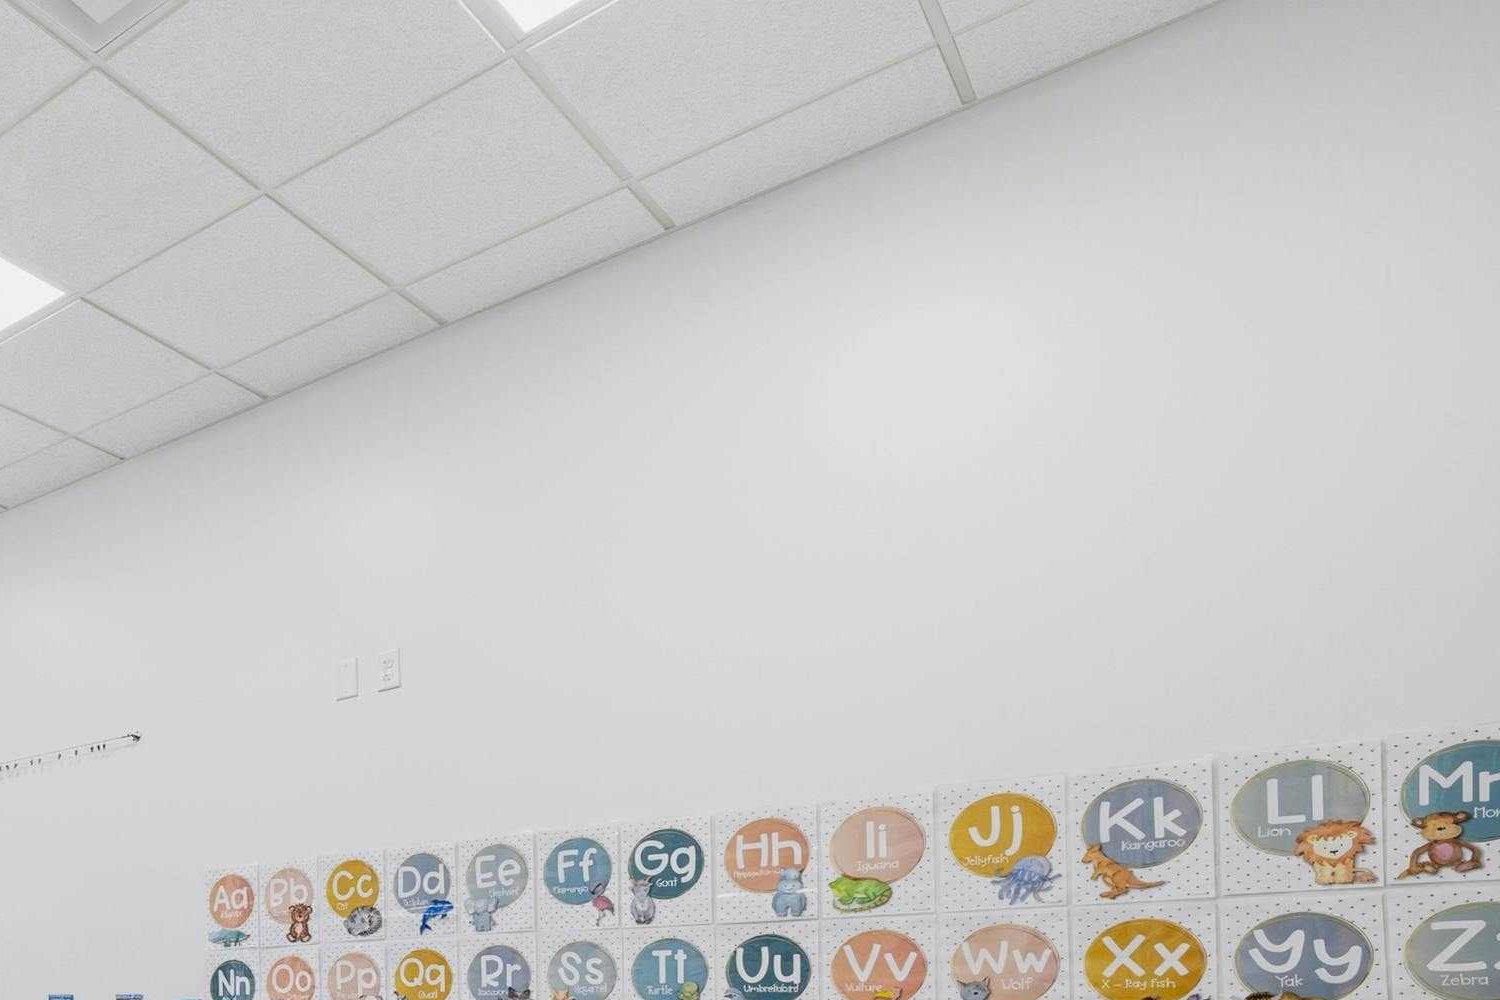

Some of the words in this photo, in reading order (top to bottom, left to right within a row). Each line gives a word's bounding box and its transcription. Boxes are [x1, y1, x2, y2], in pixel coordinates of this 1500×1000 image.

[1266, 774, 1324, 825] Ll
[968, 805, 1022, 857] Jj
[1100, 796, 1188, 843] Kk
[1257, 825, 1291, 838] Lion
[736, 831, 803, 870] Hh
[866, 821, 887, 859] Ii
[1121, 838, 1186, 852] Kangaroo
[475, 854, 521, 889] Ee
[557, 847, 597, 883] Ff
[634, 839, 697, 883] Gg
[856, 860, 899, 873] Iguana
[963, 854, 1009, 868] Jellyfish
[269, 878, 308, 907] Bb
[332, 870, 373, 901] Cc
[397, 864, 446, 898] Dd
[656, 877, 678, 888] Goat
[213, 885, 248, 912] Aa
[962, 940, 1052, 975] Ww
[1101, 933, 1189, 978] Xx
[1248, 928, 1362, 984] Yy
[1426, 919, 1500, 972] Z
[272, 964, 311, 993] Oo
[335, 960, 377, 994] Pp
[400, 957, 446, 992] Qq
[480, 954, 522, 988] Rr
[558, 951, 604, 986] Ss
[652, 949, 687, 984] Tt
[735, 946, 801, 985] Uu
[843, 943, 918, 983] Vv
[1440, 972, 1489, 986] Zebra
[218, 969, 250, 997] Nn
[646, 984, 673, 996] Turtle
[844, 982, 882, 993] Vulture
[1001, 977, 1034, 992] Wolf
[1102, 980, 1110, 989] X
[1125, 978, 1149, 990] Ray
[1151, 977, 1176, 989] Fish
[1275, 974, 1304, 988] Yak
